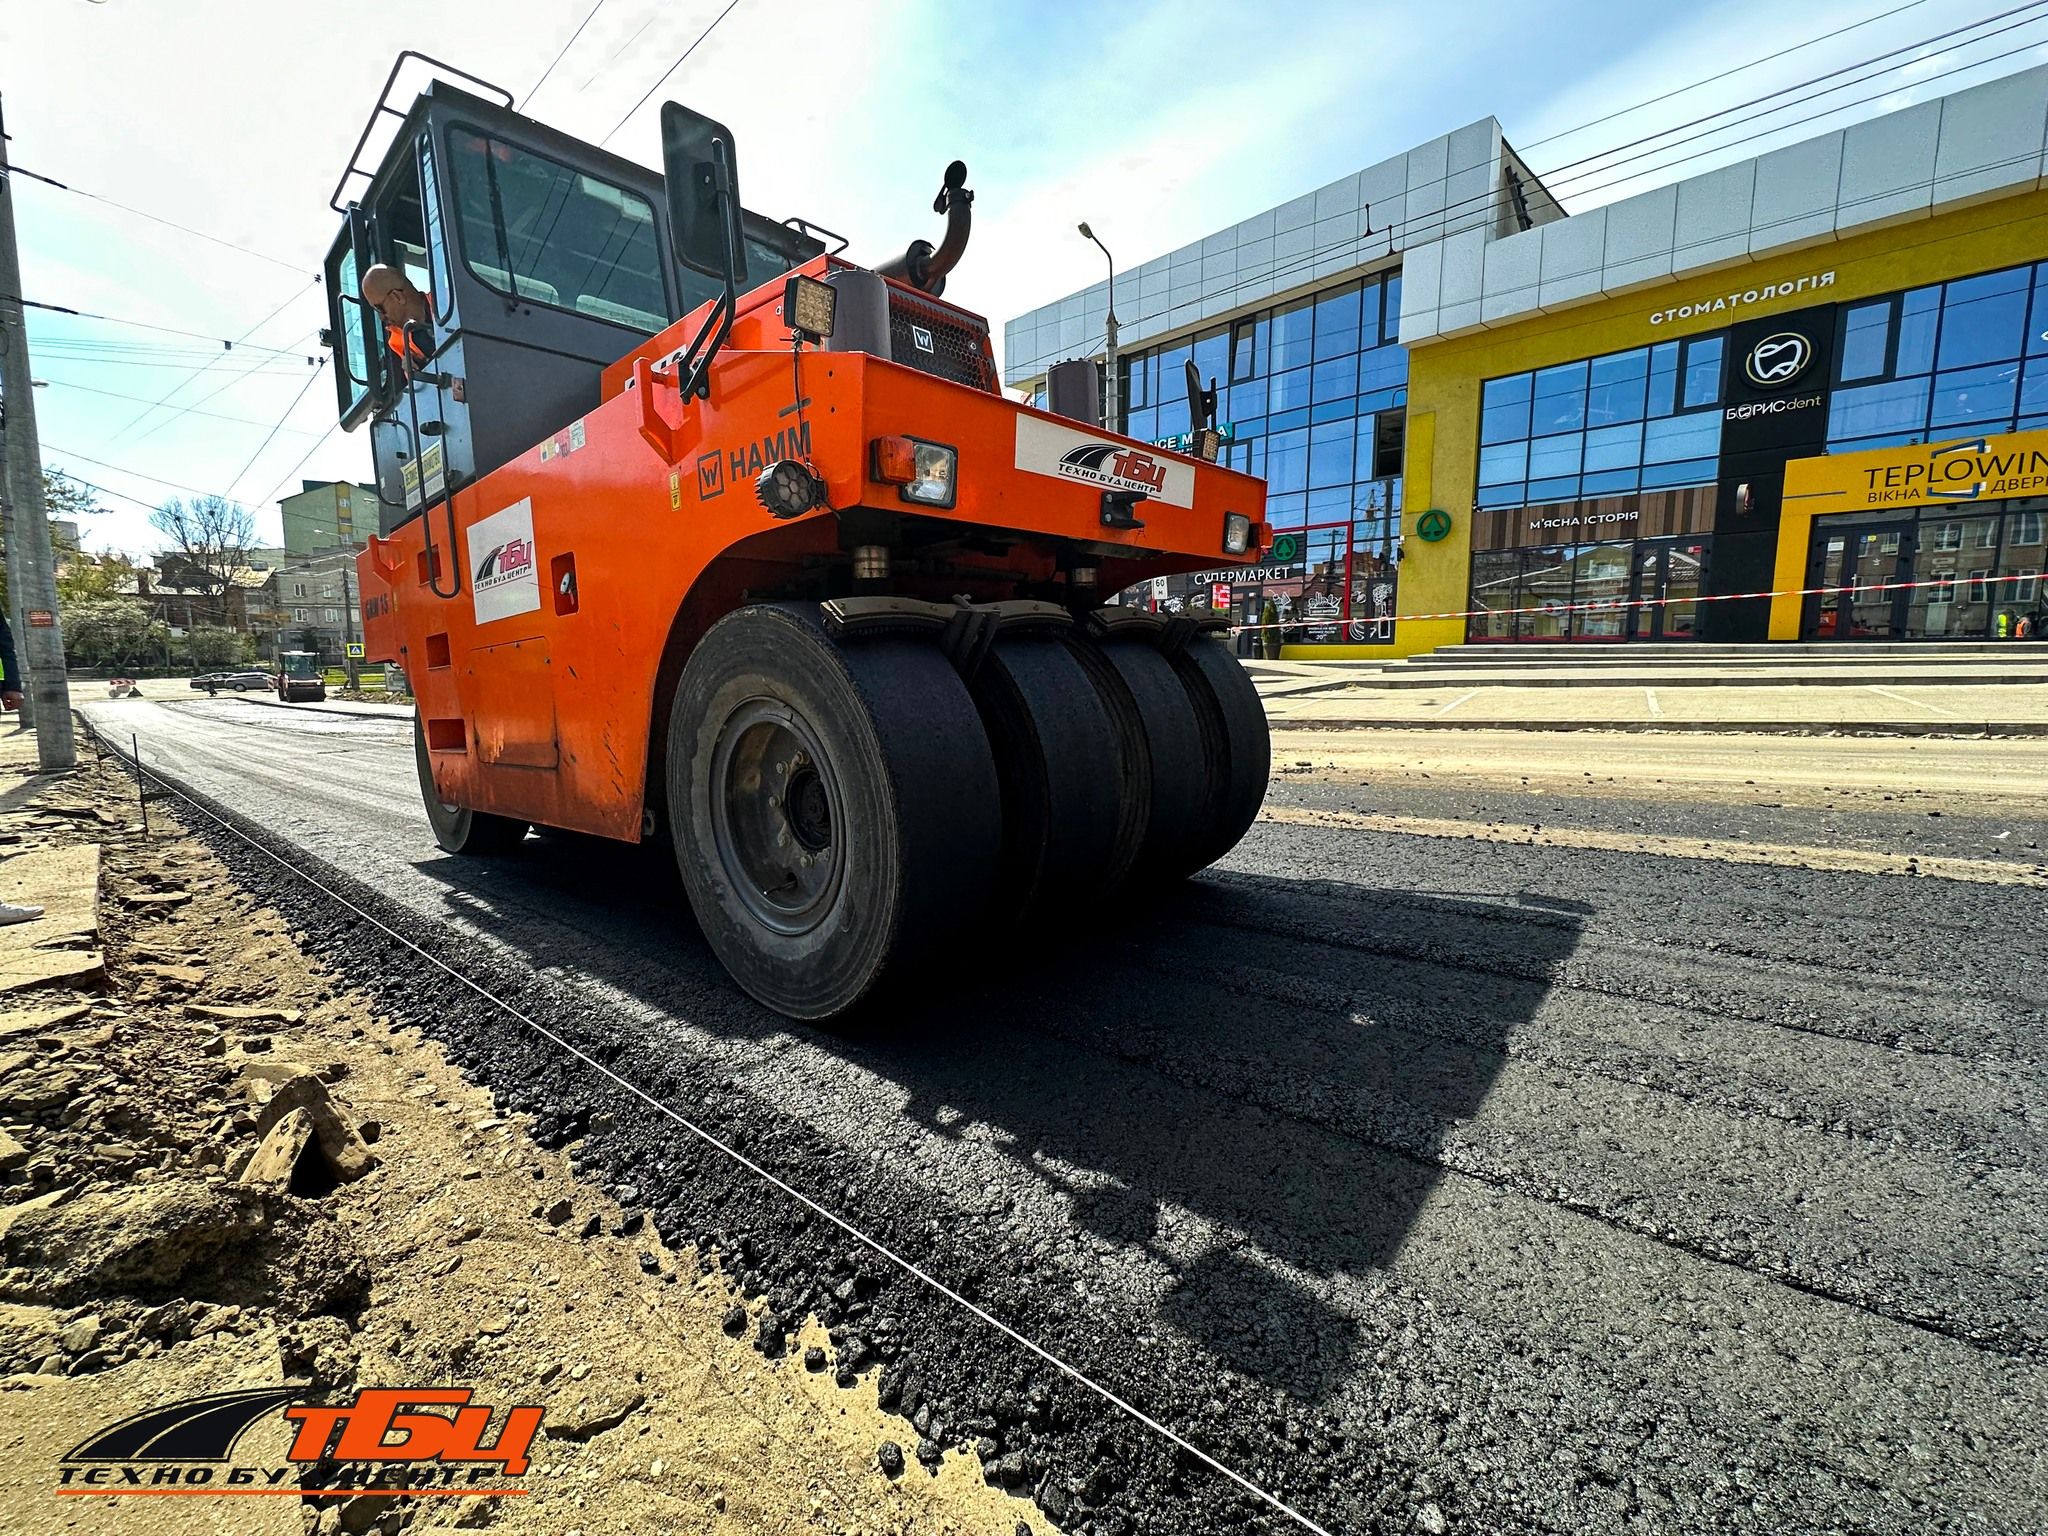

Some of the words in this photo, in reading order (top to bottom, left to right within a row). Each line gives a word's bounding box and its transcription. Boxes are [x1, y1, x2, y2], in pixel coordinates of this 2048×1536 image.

[1650, 271, 1836, 325] СТОМАТОЛОГІЯ
[730, 421, 812, 482] HAMM
[1058, 463, 1097, 479] ТЕХНО
[1099, 473, 1122, 486] БУД
[1123, 480, 1156, 493] ЦЕНТР
[1868, 488, 1921, 503] ВІКНА
[1990, 475, 2048, 494] ДВЕР
[1530, 517, 1580, 530] М'ЯСНА
[1584, 511, 1639, 525] ІСТОРІЯ
[474, 578, 493, 591] ТЕХНО
[507, 566, 528, 580] ЦЕНТР
[1155, 579, 1165, 588] 60
[1194, 566, 1290, 585] СУПЕРМАРКЕТ
